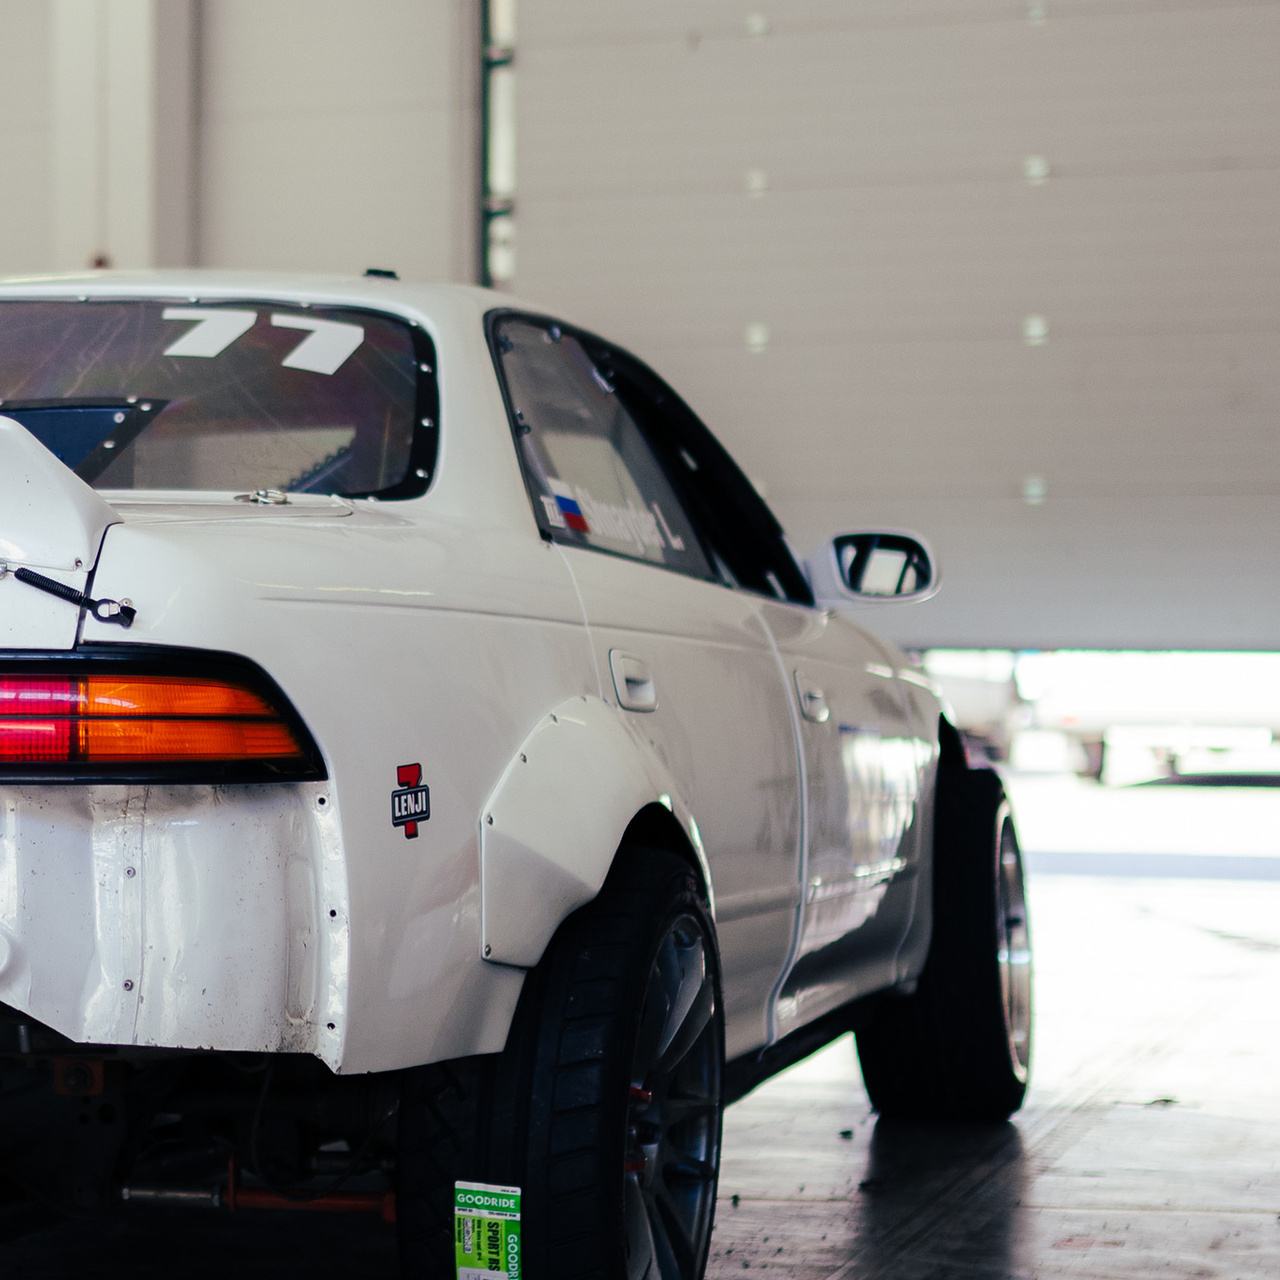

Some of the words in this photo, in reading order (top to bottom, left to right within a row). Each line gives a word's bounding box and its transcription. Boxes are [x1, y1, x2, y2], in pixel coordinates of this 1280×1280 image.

[163, 308, 365, 375] 77
[394, 791, 427, 817] LENJI
[457, 1194, 516, 1209] GOODRIDE
[487, 1221, 500, 1256] SPORT
[488, 1258, 501, 1271] RS
